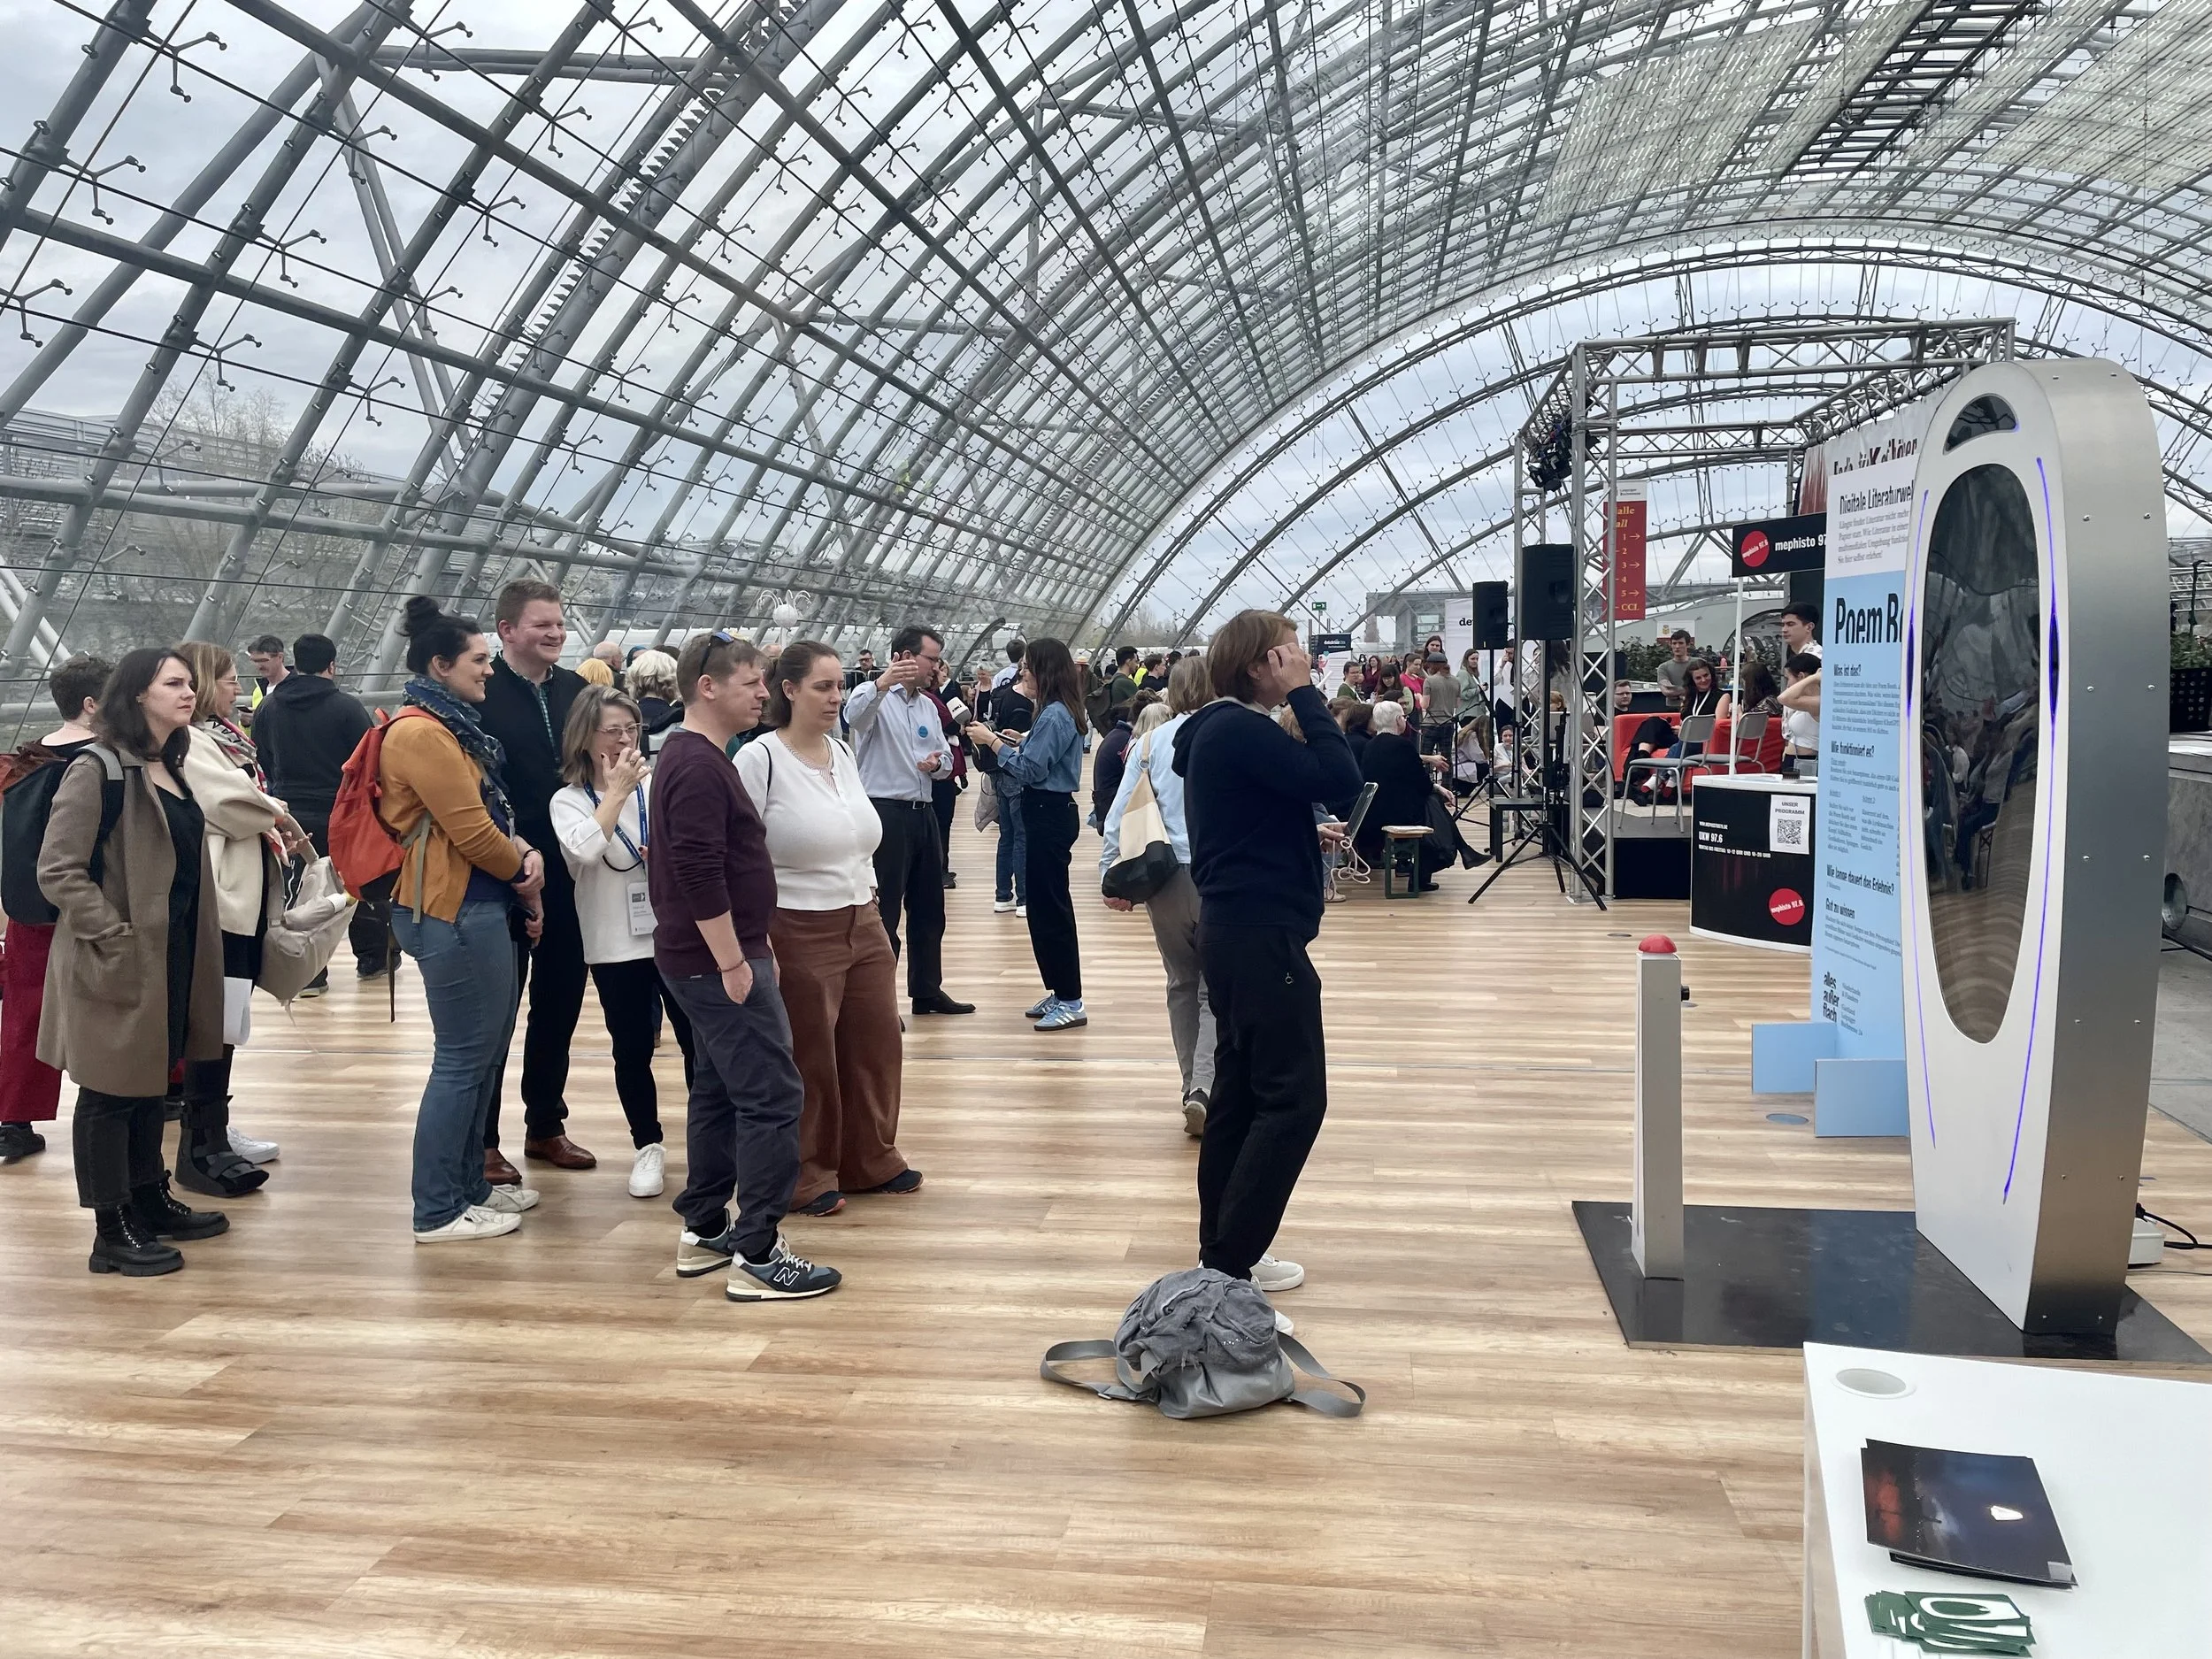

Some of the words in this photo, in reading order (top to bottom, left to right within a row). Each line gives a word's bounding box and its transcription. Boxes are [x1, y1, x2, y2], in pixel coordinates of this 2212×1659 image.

[1840, 491, 1866, 515] Digitale
[1868, 480, 1914, 509] Literaturwel
[1616, 506, 1635, 516] alle
[1616, 518, 1628, 528] all
[1758, 539, 1769, 549] 97.6
[1775, 536, 1816, 553] mephisto
[1459, 618, 1473, 626] de
[1835, 597, 1883, 644] Poem
[1840, 741, 1865, 757] funktioniert
[1865, 745, 1875, 757] es?
[1699, 831, 1709, 841] UKW
[1710, 833, 1724, 844] 97.6
[1826, 864, 1835, 878] Wie
[1847, 871, 1863, 887] dauert
[1863, 874, 1872, 889] das
[1872, 878, 1894, 896] Erlebnis?
[1770, 903, 1791, 914] mephisto
[1833, 902, 1839, 914] zu
[1840, 903, 1855, 919] wissen
[1824, 972, 1837, 989] alles
[1823, 989, 1839, 1007] außer
[1823, 1002, 1837, 1023] flach
[773, 1267, 800, 1286] N
